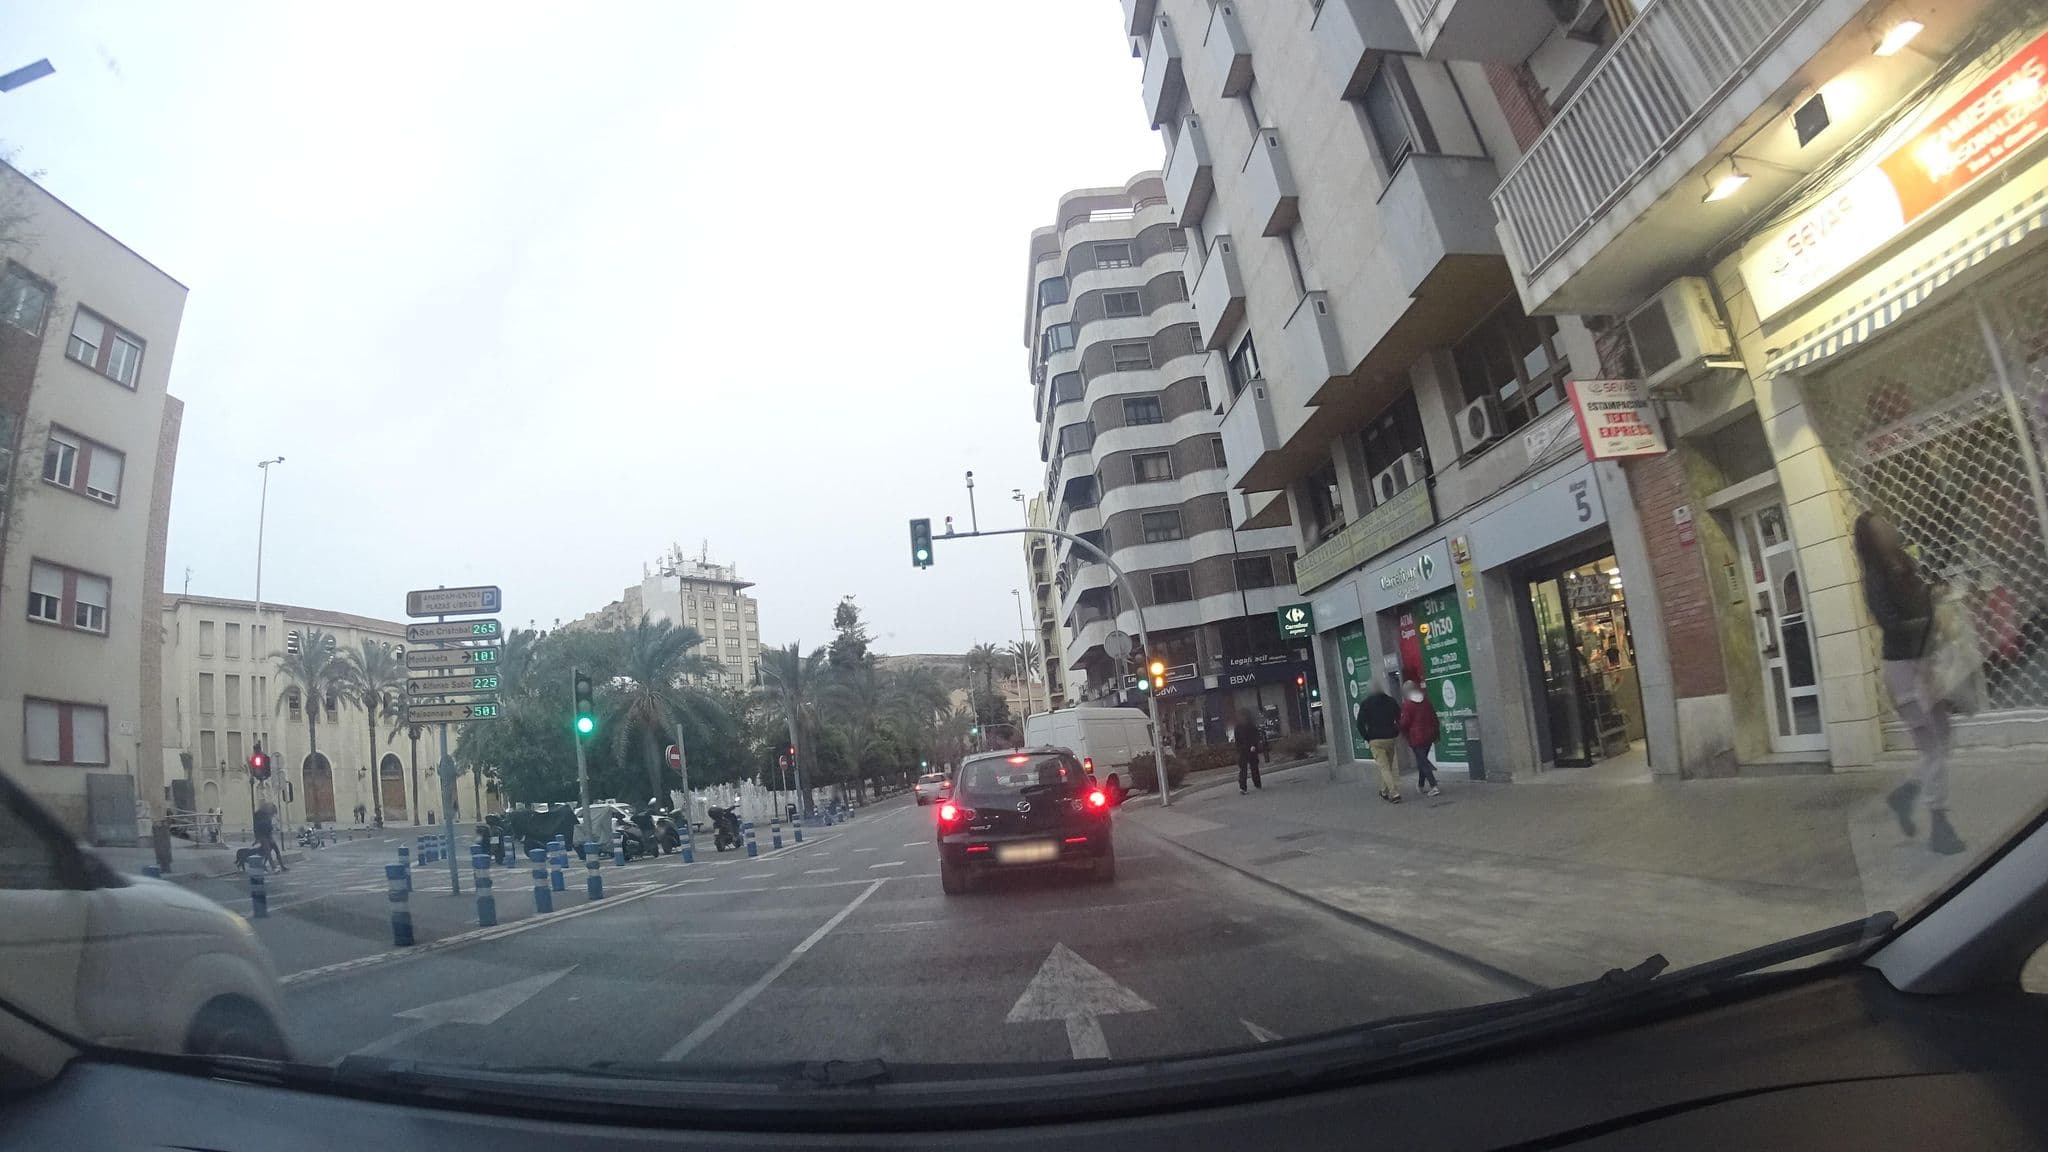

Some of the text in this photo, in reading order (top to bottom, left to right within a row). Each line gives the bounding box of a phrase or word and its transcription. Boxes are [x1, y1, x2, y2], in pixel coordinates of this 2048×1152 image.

[1575, 490, 1592, 522] 5
[420, 628, 435, 637] San
[472, 623, 497, 634] 265
[473, 677, 497, 689] 225
[1230, 672, 1256, 685] BBVA
[474, 705, 497, 717] 501
